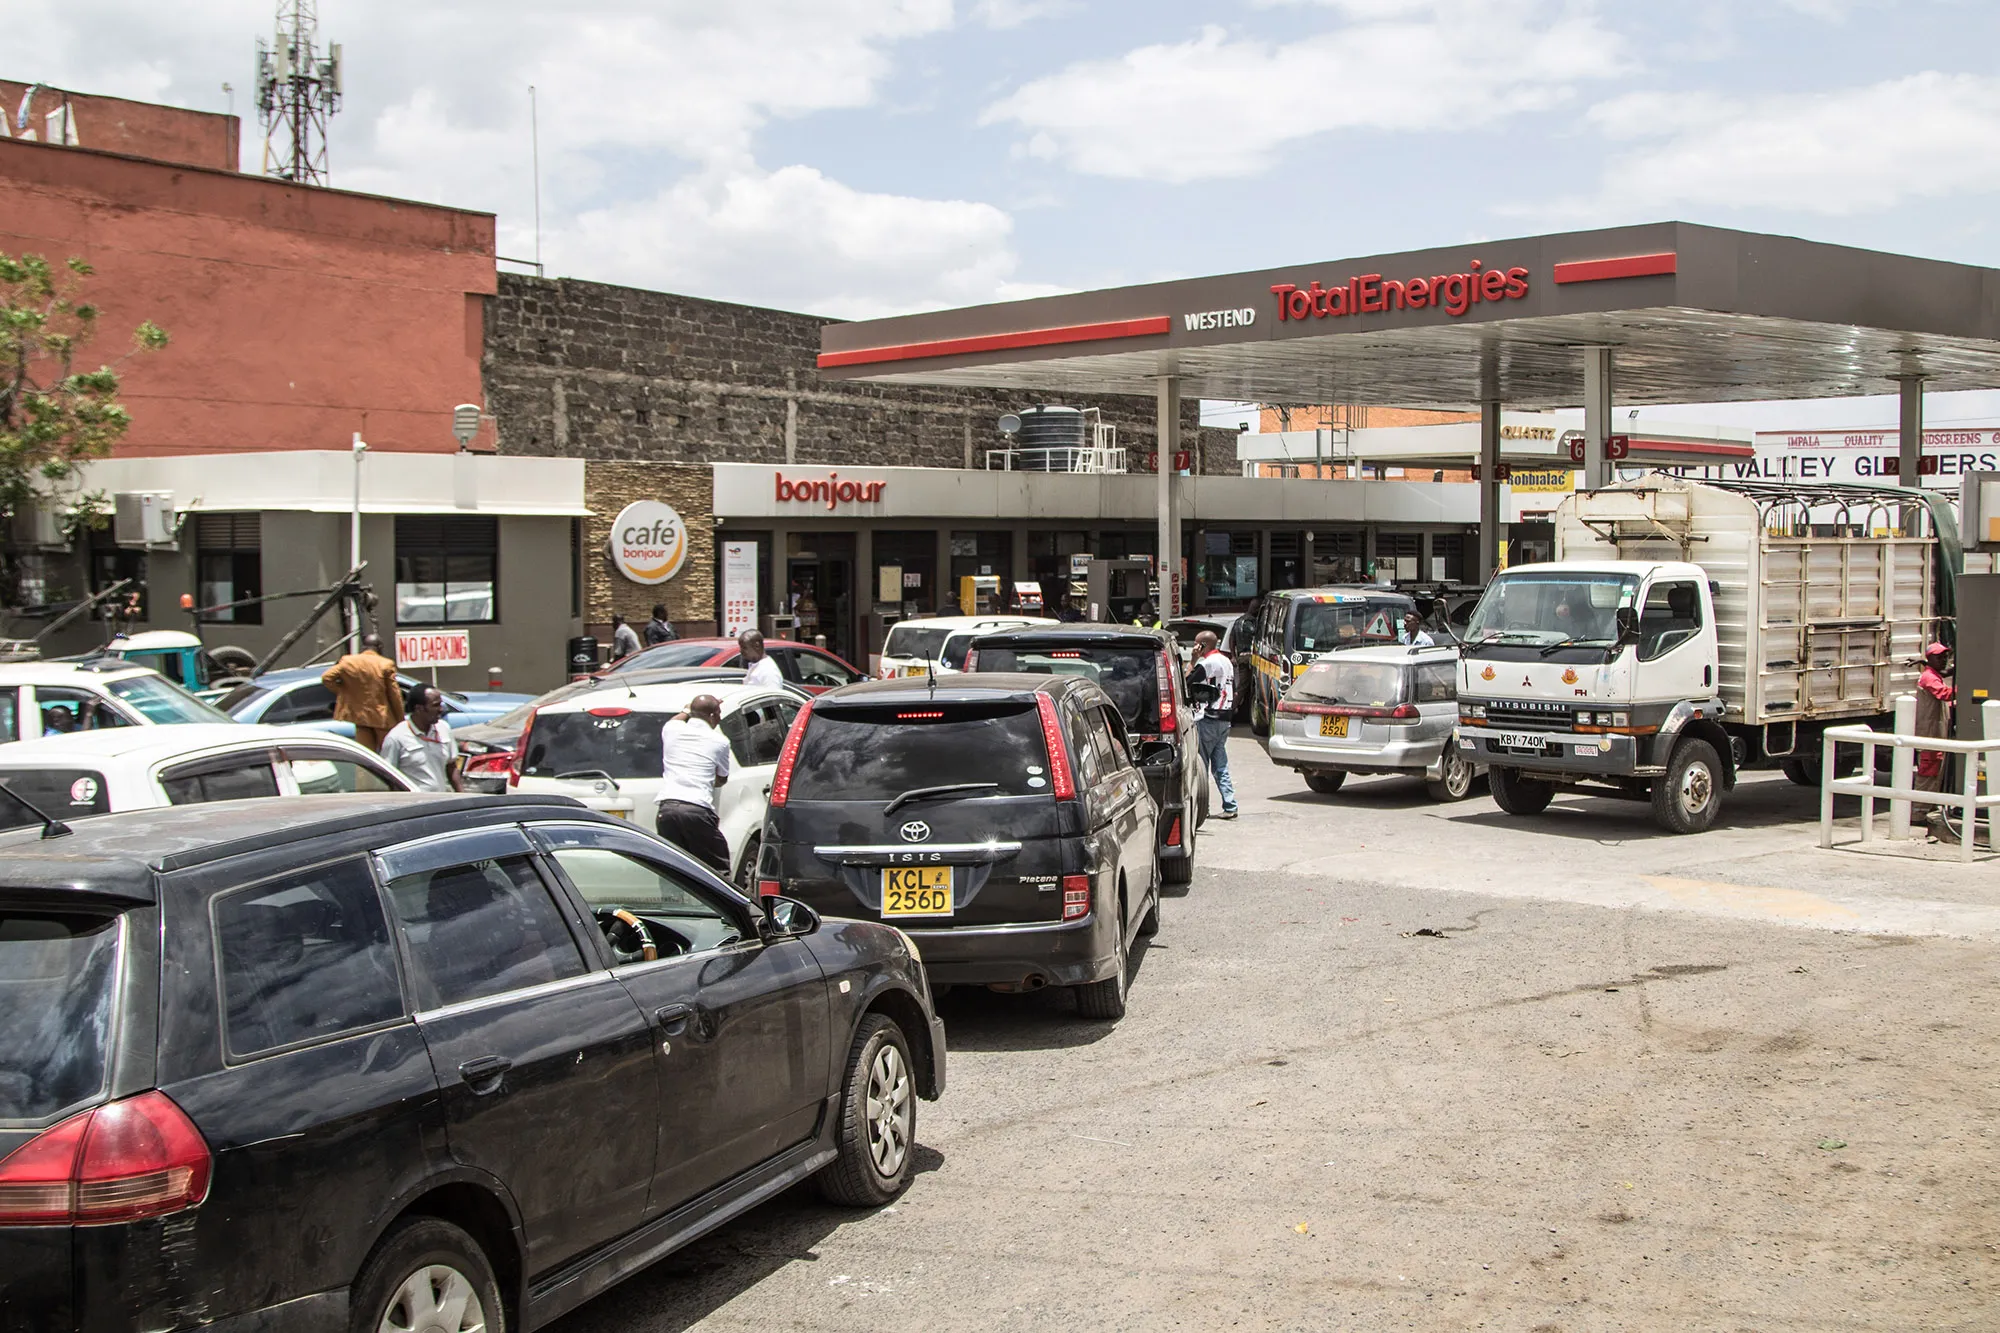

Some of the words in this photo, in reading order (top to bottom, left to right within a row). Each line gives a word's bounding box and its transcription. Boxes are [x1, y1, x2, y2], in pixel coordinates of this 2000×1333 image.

[1271, 259, 1529, 321] TotalEnergies
[1185, 308, 1256, 331] WESTEND
[1500, 425, 1557, 441] QUARTZ
[1787, 436, 1820, 447] IMPALA
[1844, 435, 1885, 447] QUALITY
[1574, 441, 1584, 458] 6
[1612, 439, 1622, 456] 5
[1178, 454, 1185, 467] 7
[1733, 456, 1836, 478] VALLEY
[1887, 459, 1896, 473] 2
[1924, 458, 1931, 471] 1
[1500, 465, 1506, 477] 3
[775, 472, 887, 510] bonjour
[622, 520, 675, 546] café
[623, 547, 667, 561] bonjour
[400, 637, 418, 662] NO
[420, 636, 467, 661] PARKING
[1292, 654, 1302, 662] 80
[1490, 701, 1566, 711] MITSUBISHI
[1322, 725, 1345, 736] 252L
[888, 852, 941, 862] ISIS
[888, 869, 931, 890] KCL
[888, 891, 946, 911] 256D
